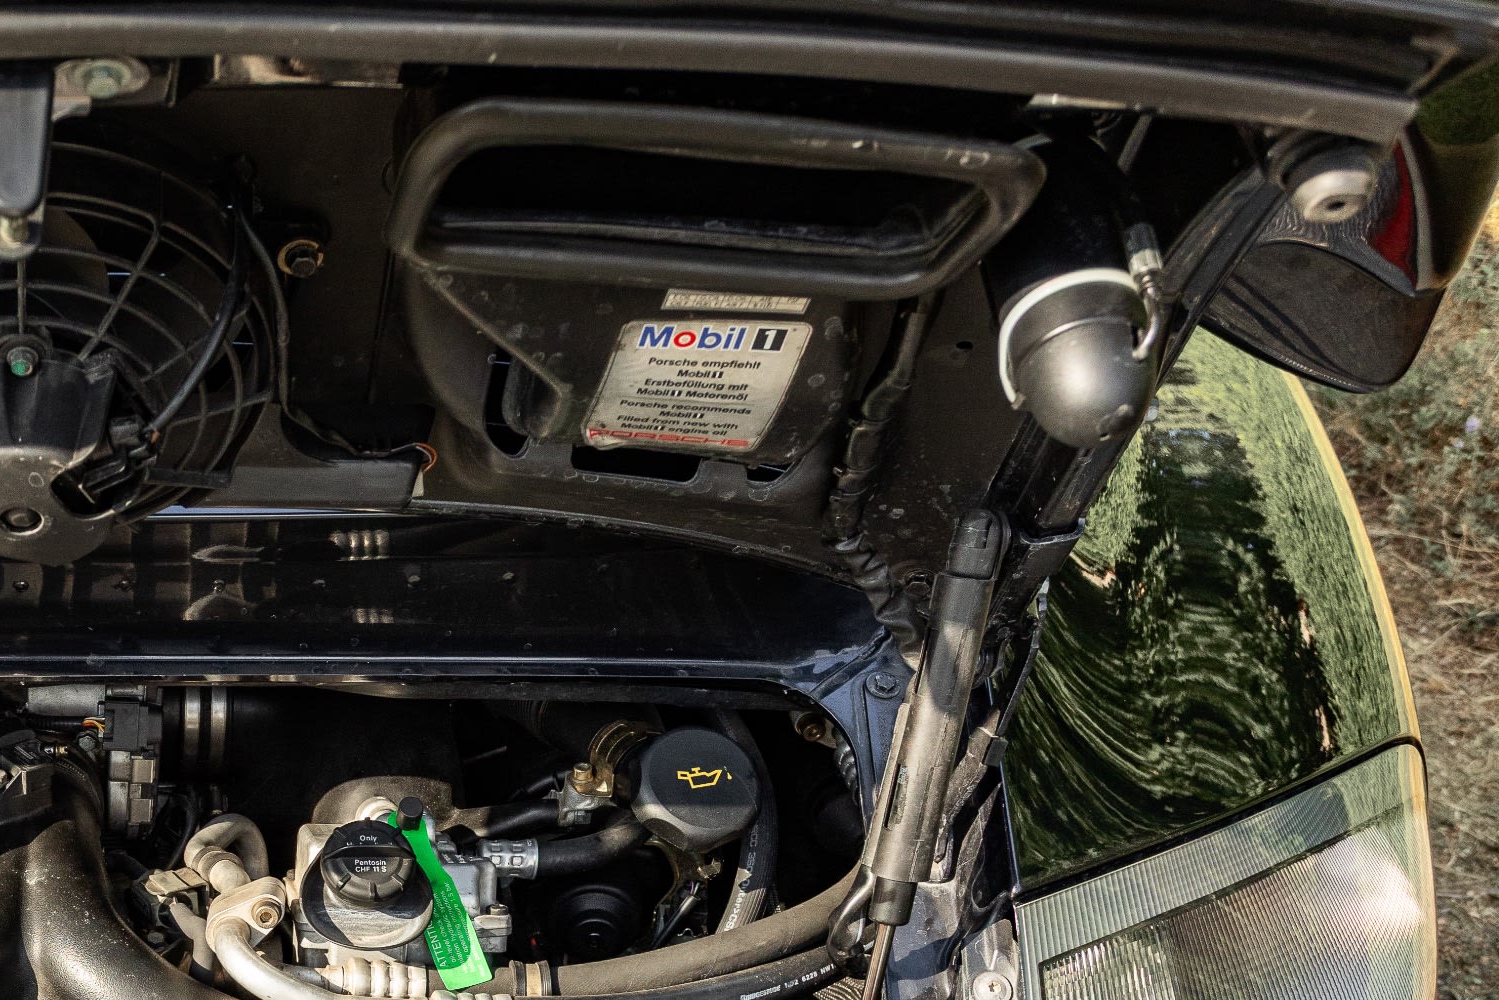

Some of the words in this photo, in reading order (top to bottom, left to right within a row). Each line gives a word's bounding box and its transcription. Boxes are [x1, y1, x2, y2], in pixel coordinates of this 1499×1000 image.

[638, 326, 747, 349] Mobil
[648, 358, 698, 367] Porsche
[702, 360, 761, 370] empfiehlt
[644, 378, 725, 391] Erstbefüllung
[685, 391, 748, 401] Motorenöl
[619, 400, 669, 410] Porsche
[671, 403, 752, 415] recommends
[616, 415, 649, 424] Filled
[652, 418, 681, 426] from
[587, 428, 751, 447] PORSCHE
[668, 427, 710, 436] engine
[359, 834, 378, 843] Only
[426, 920, 447, 967] ATTENTI
[801, 972, 818, 982] 6228
[820, 963, 837, 974] NW1
